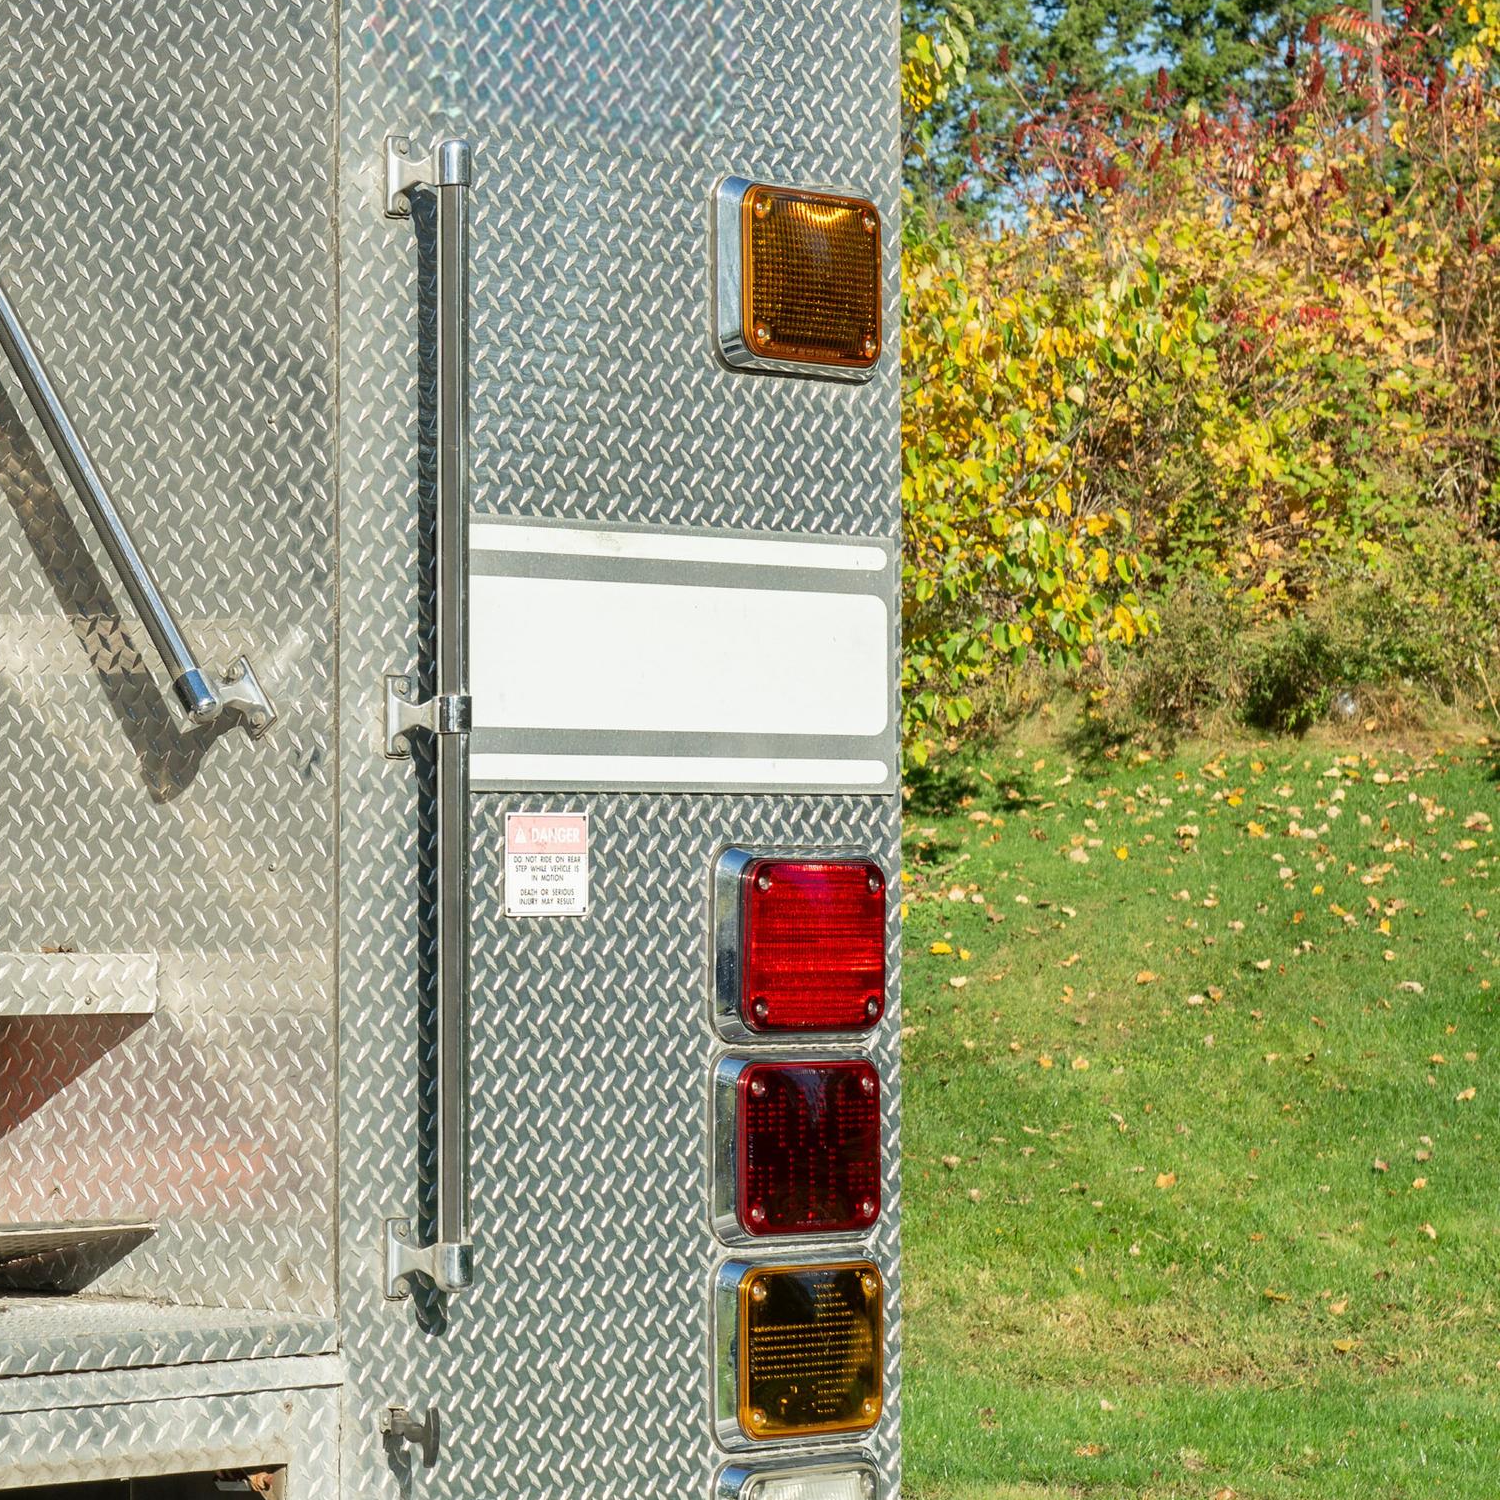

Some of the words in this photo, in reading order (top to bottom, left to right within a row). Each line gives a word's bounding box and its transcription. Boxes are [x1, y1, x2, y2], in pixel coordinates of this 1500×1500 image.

[531, 827, 580, 844] DANGER
[515, 865, 527, 873] STEP
[531, 865, 547, 873] WHILE
[551, 865, 571, 873] VEHICLE
[574, 865, 579, 873] IS
